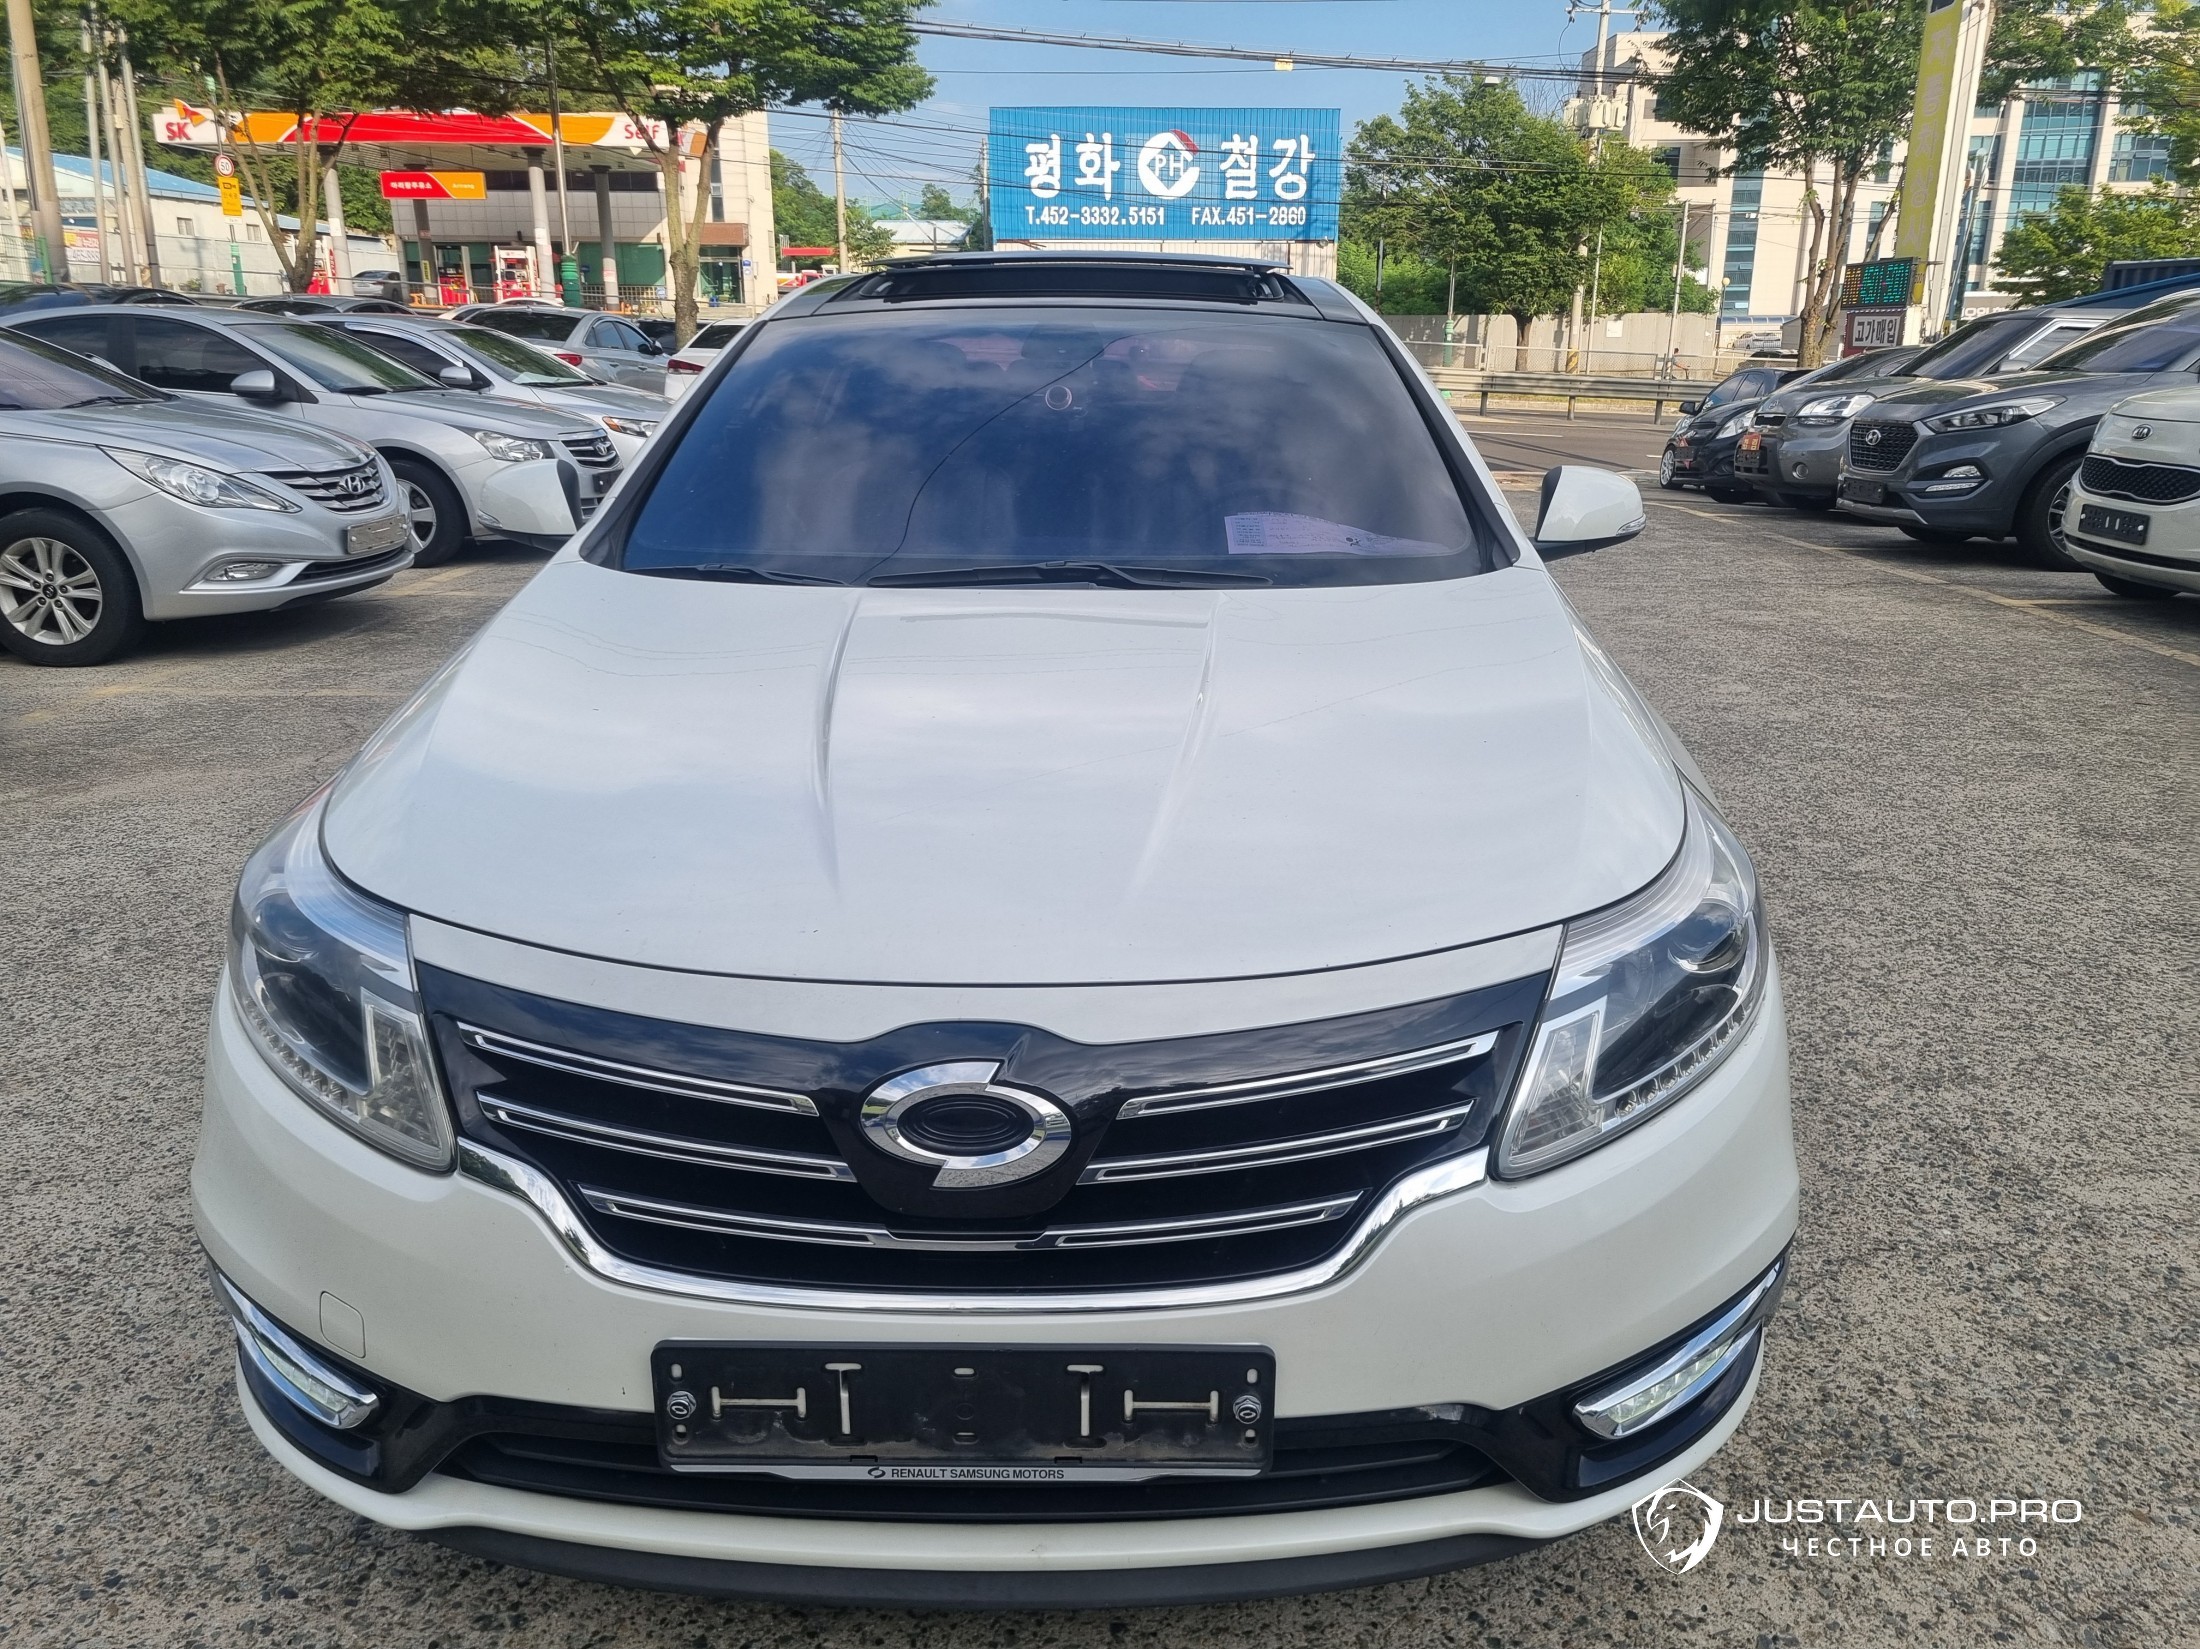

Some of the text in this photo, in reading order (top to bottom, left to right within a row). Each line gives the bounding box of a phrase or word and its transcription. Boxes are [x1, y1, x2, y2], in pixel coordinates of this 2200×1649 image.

[165, 122, 192, 140] SK
[220, 161, 230, 171] 50
[1024, 132, 1121, 200] 평화
[1154, 153, 1184, 177] PH
[1219, 133, 1316, 200] 철강
[1025, 206, 1166, 226] T.452-3332.5151
[1854, 318, 1898, 345] 고가매입
[891, 1468, 1065, 1479] RENAULT SAMSUNG MOTORS
